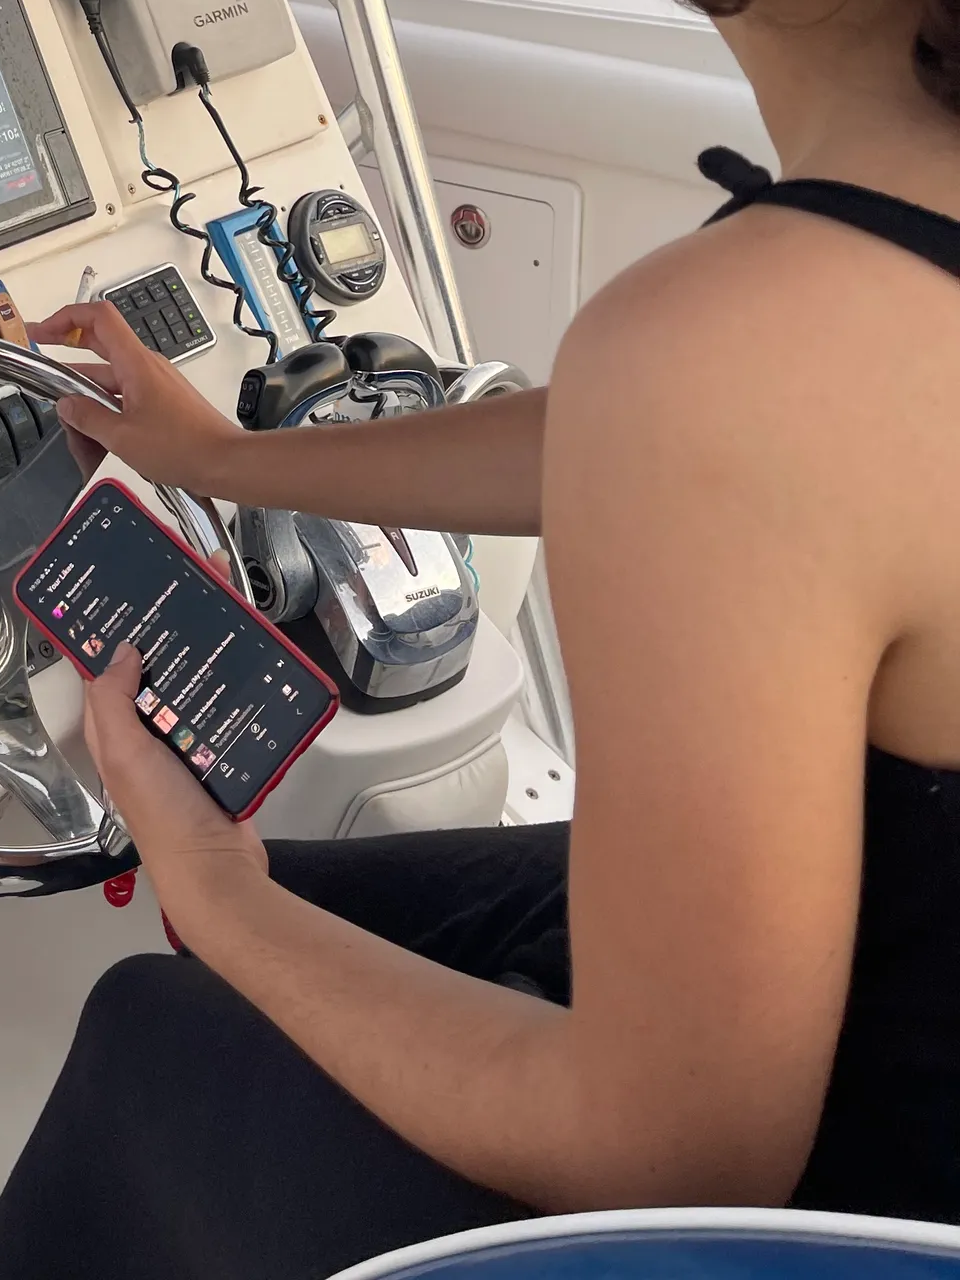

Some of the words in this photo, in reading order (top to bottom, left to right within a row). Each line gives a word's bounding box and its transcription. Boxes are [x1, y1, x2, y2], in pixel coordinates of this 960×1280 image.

[193, 2, 249, 28] GARMIN
[185, 334, 208, 348] SUZUKI
[284, 333, 300, 345] TRIM
[242, 382, 254, 391] UP
[239, 401, 252, 410] DN
[390, 532, 400, 541] R
[47, 578, 61, 592] Your
[58, 561, 74, 579] Likes
[405, 587, 440, 603] SUZUKI
[142, 605, 157, 621] Society
[178, 645, 189, 657] Paris
[198, 662, 209, 674] Baby
[221, 631, 235, 647] Down)
[200, 693, 217, 712] Madame
[216, 683, 226, 694] Blue
[230, 707, 240, 718] Lies
